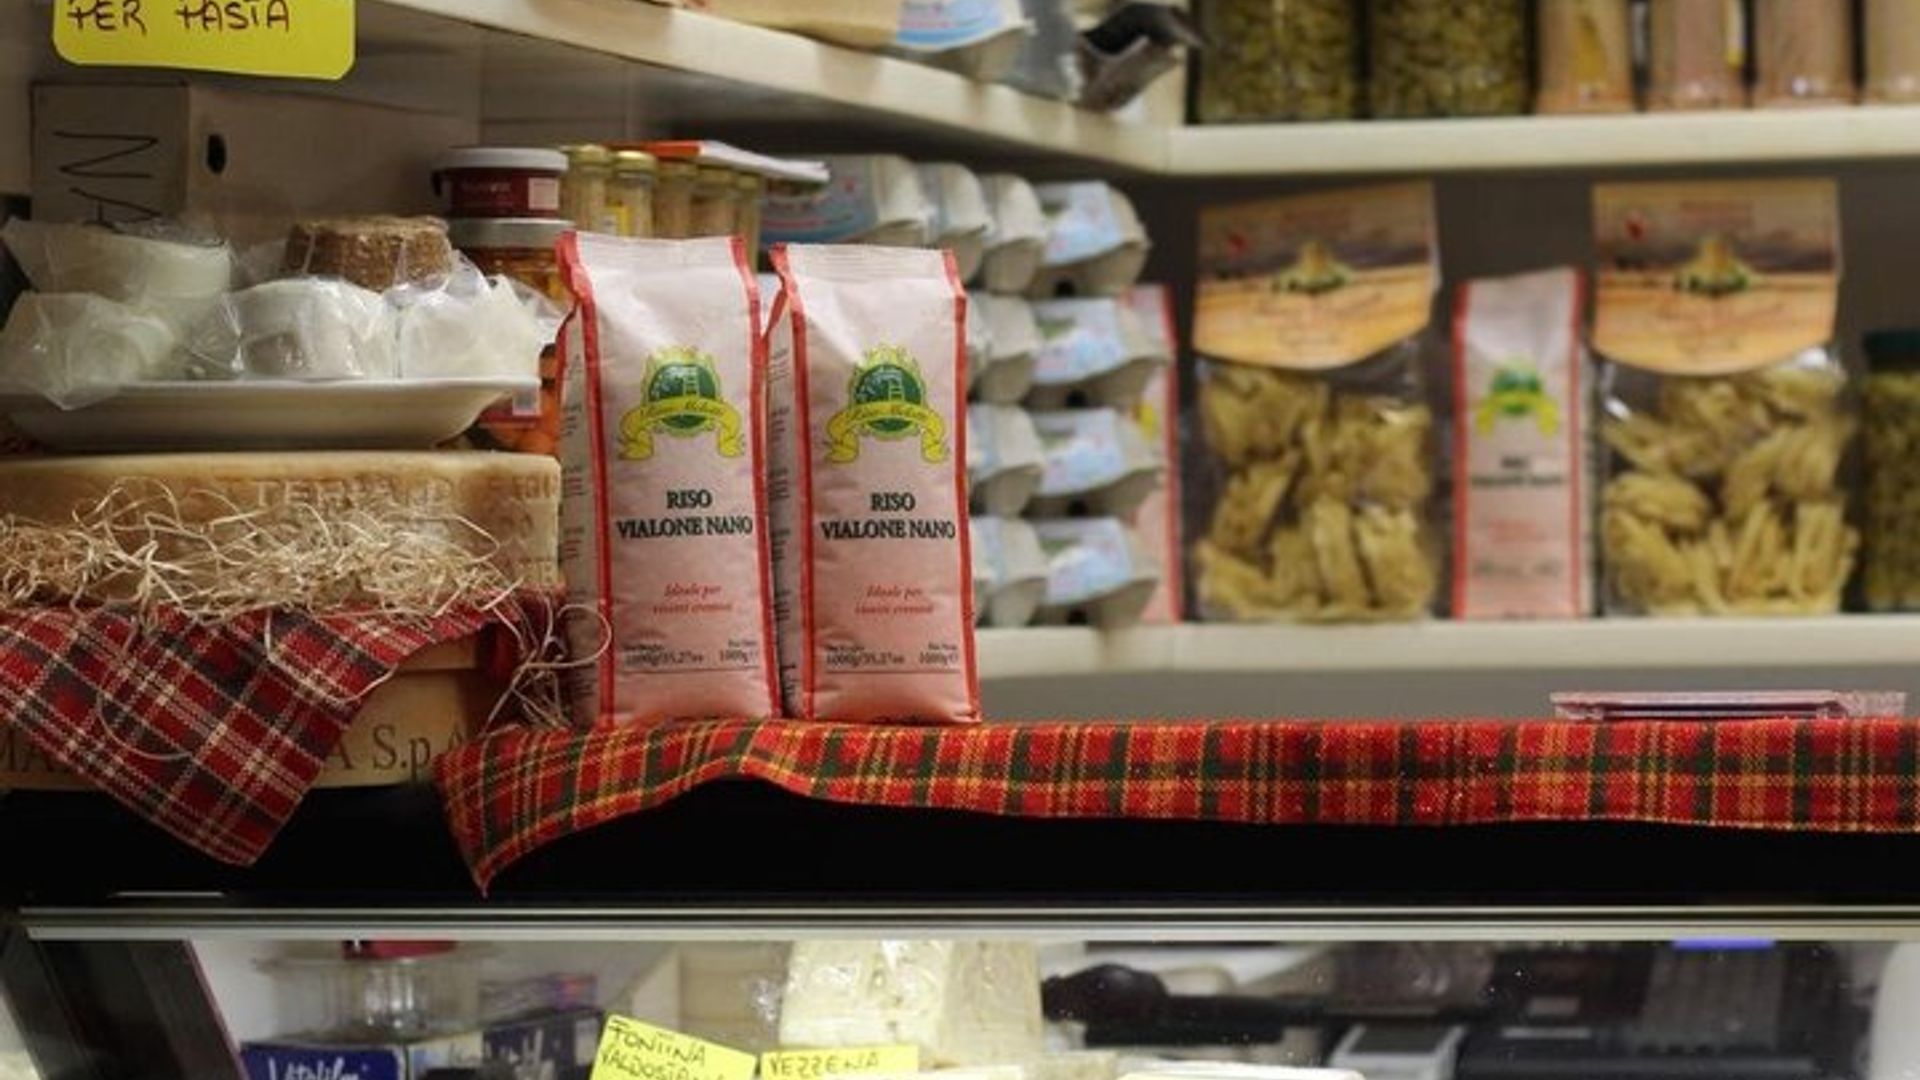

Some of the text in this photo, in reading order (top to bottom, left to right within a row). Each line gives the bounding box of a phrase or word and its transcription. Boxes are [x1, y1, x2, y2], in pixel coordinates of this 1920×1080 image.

[666, 489, 713, 510] RISO
[870, 492, 916, 512] RISO
[616, 516, 753, 539] VIALONE NANO
[821, 520, 956, 540] VIALONE NANO
[372, 723, 464, 782] S.p
